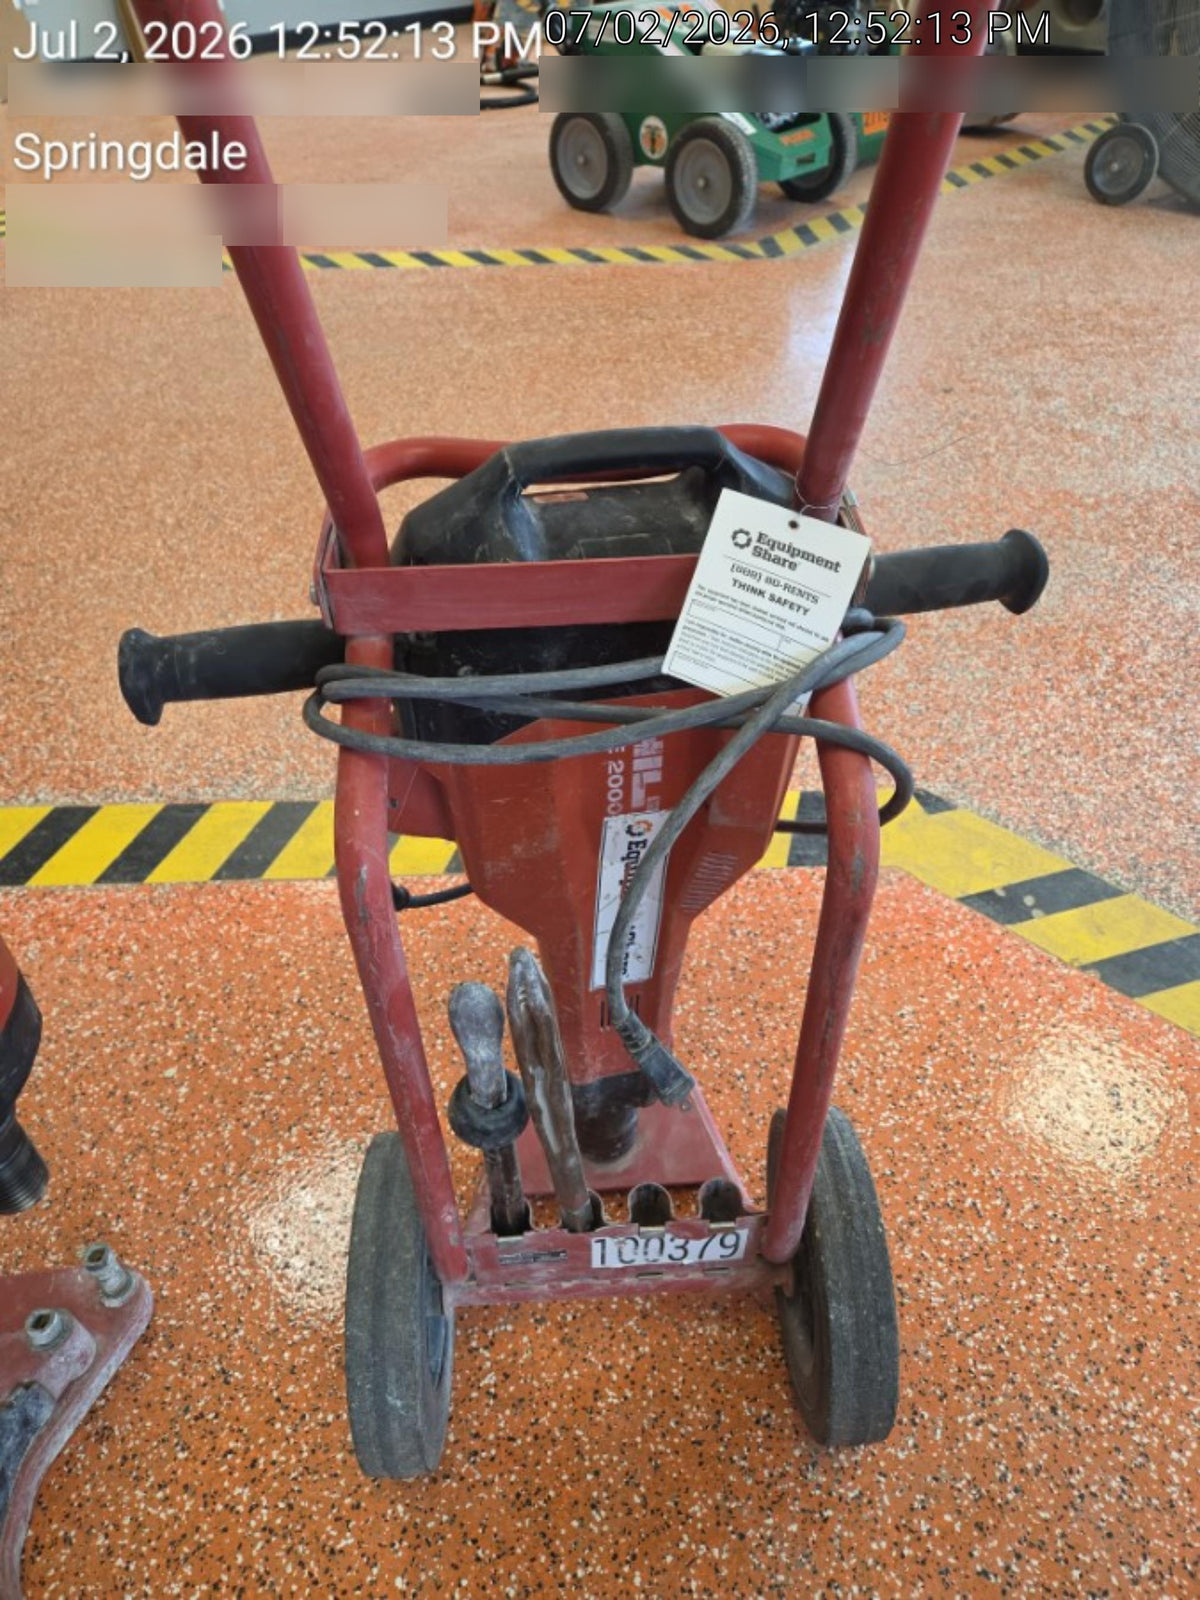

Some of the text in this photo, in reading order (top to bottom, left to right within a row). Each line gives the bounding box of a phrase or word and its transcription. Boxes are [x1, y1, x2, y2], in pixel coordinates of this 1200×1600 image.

[752, 545, 798, 571] Share
[756, 531, 841, 573] Equipment
[731, 578, 811, 616] THINK SAFETY
